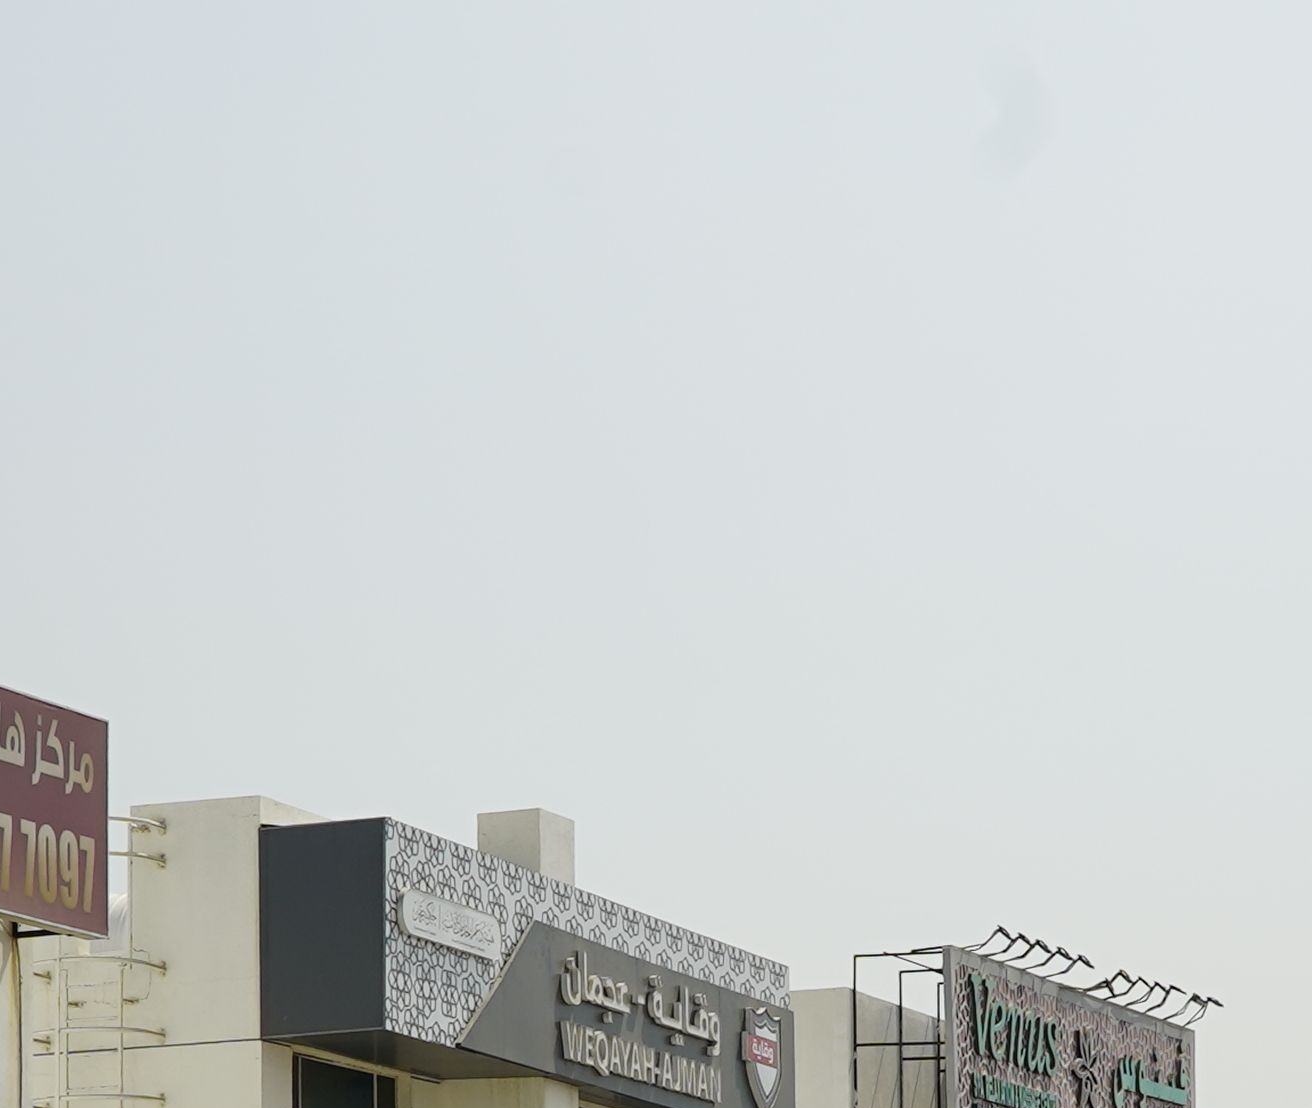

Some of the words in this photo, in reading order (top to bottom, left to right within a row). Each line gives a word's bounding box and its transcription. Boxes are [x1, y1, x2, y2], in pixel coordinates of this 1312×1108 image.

[31, 712, 94, 795] مركز
[20, 818, 96, 913] 7097
[560, 1020, 722, 1103] WEQAYAH-AJMAN
[969, 973, 1058, 1078] Venus
